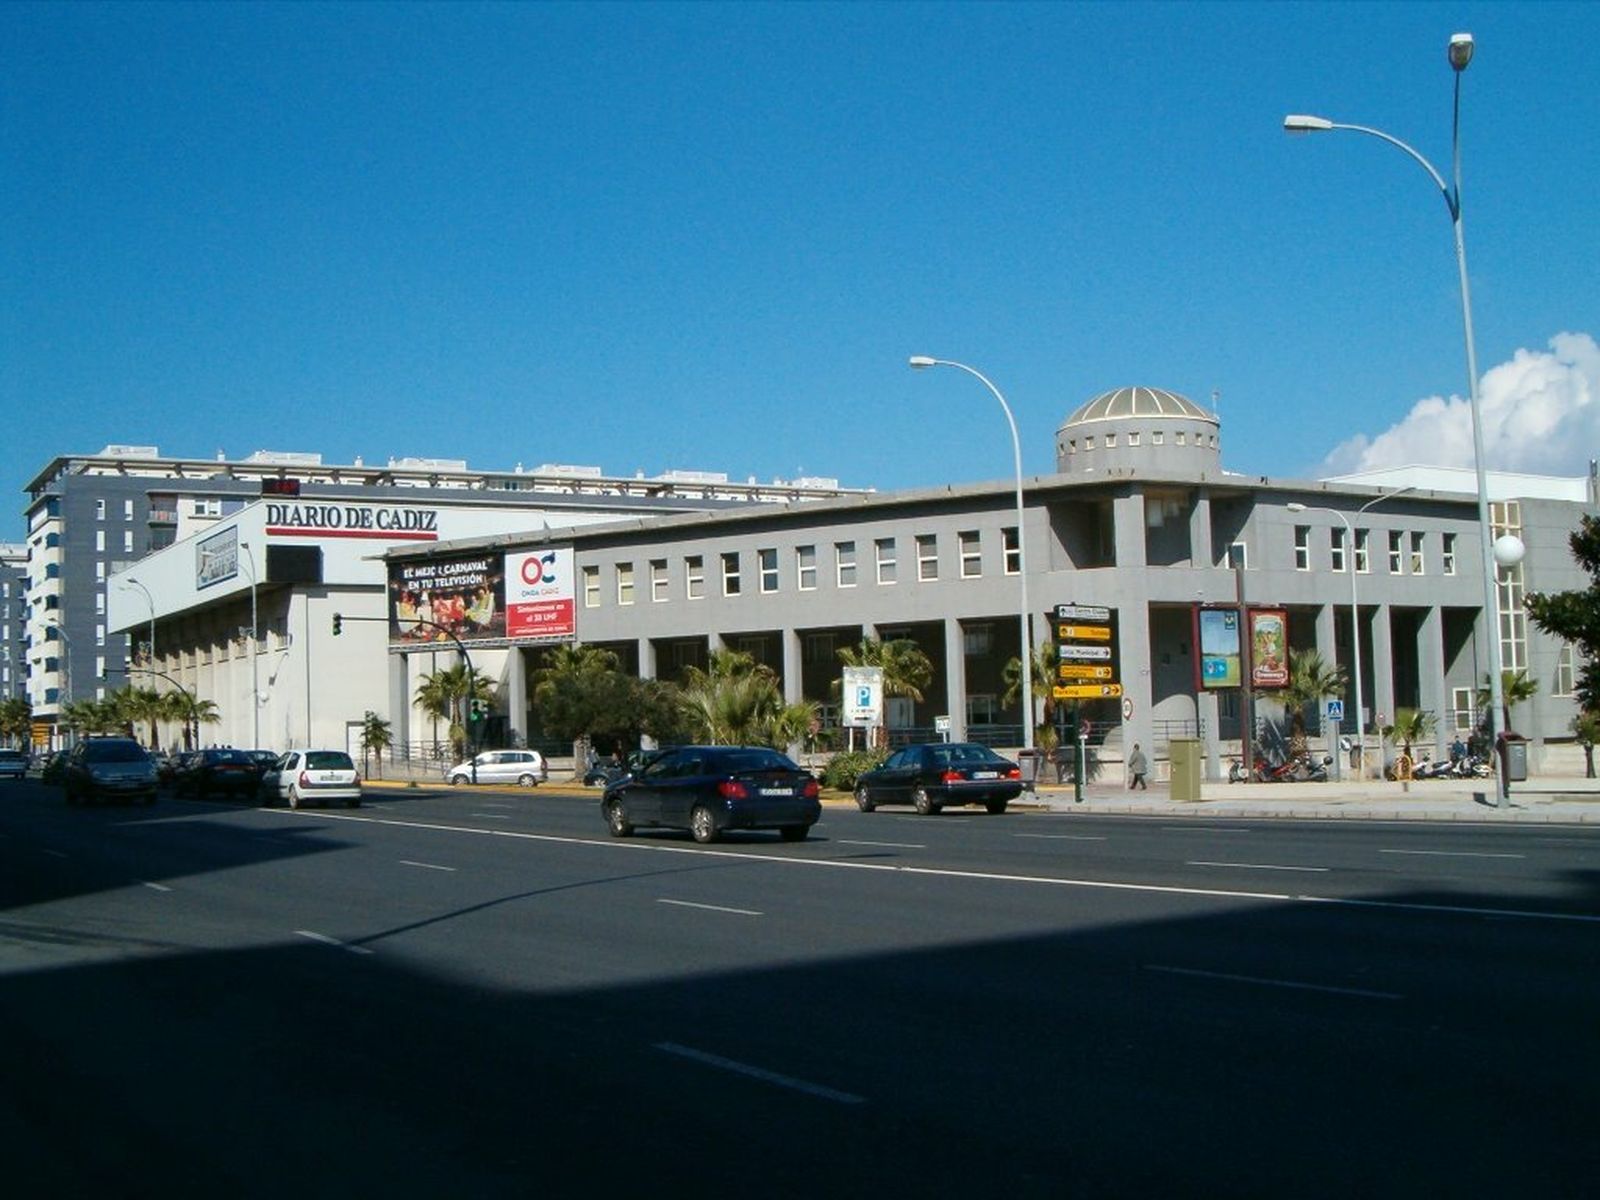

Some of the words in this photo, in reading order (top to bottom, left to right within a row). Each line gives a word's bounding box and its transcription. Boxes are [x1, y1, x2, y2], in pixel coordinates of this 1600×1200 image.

[265, 504, 342, 529] DIARIO
[345, 508, 372, 529] DE
[376, 508, 438, 532] CADIZ
[403, 569, 414, 578] EL
[443, 561, 488, 574] CARNAVAL
[408, 580, 420, 590] EN
[421, 579, 434, 588] TU
[434, 573, 483, 587] TELEVISIÓN
